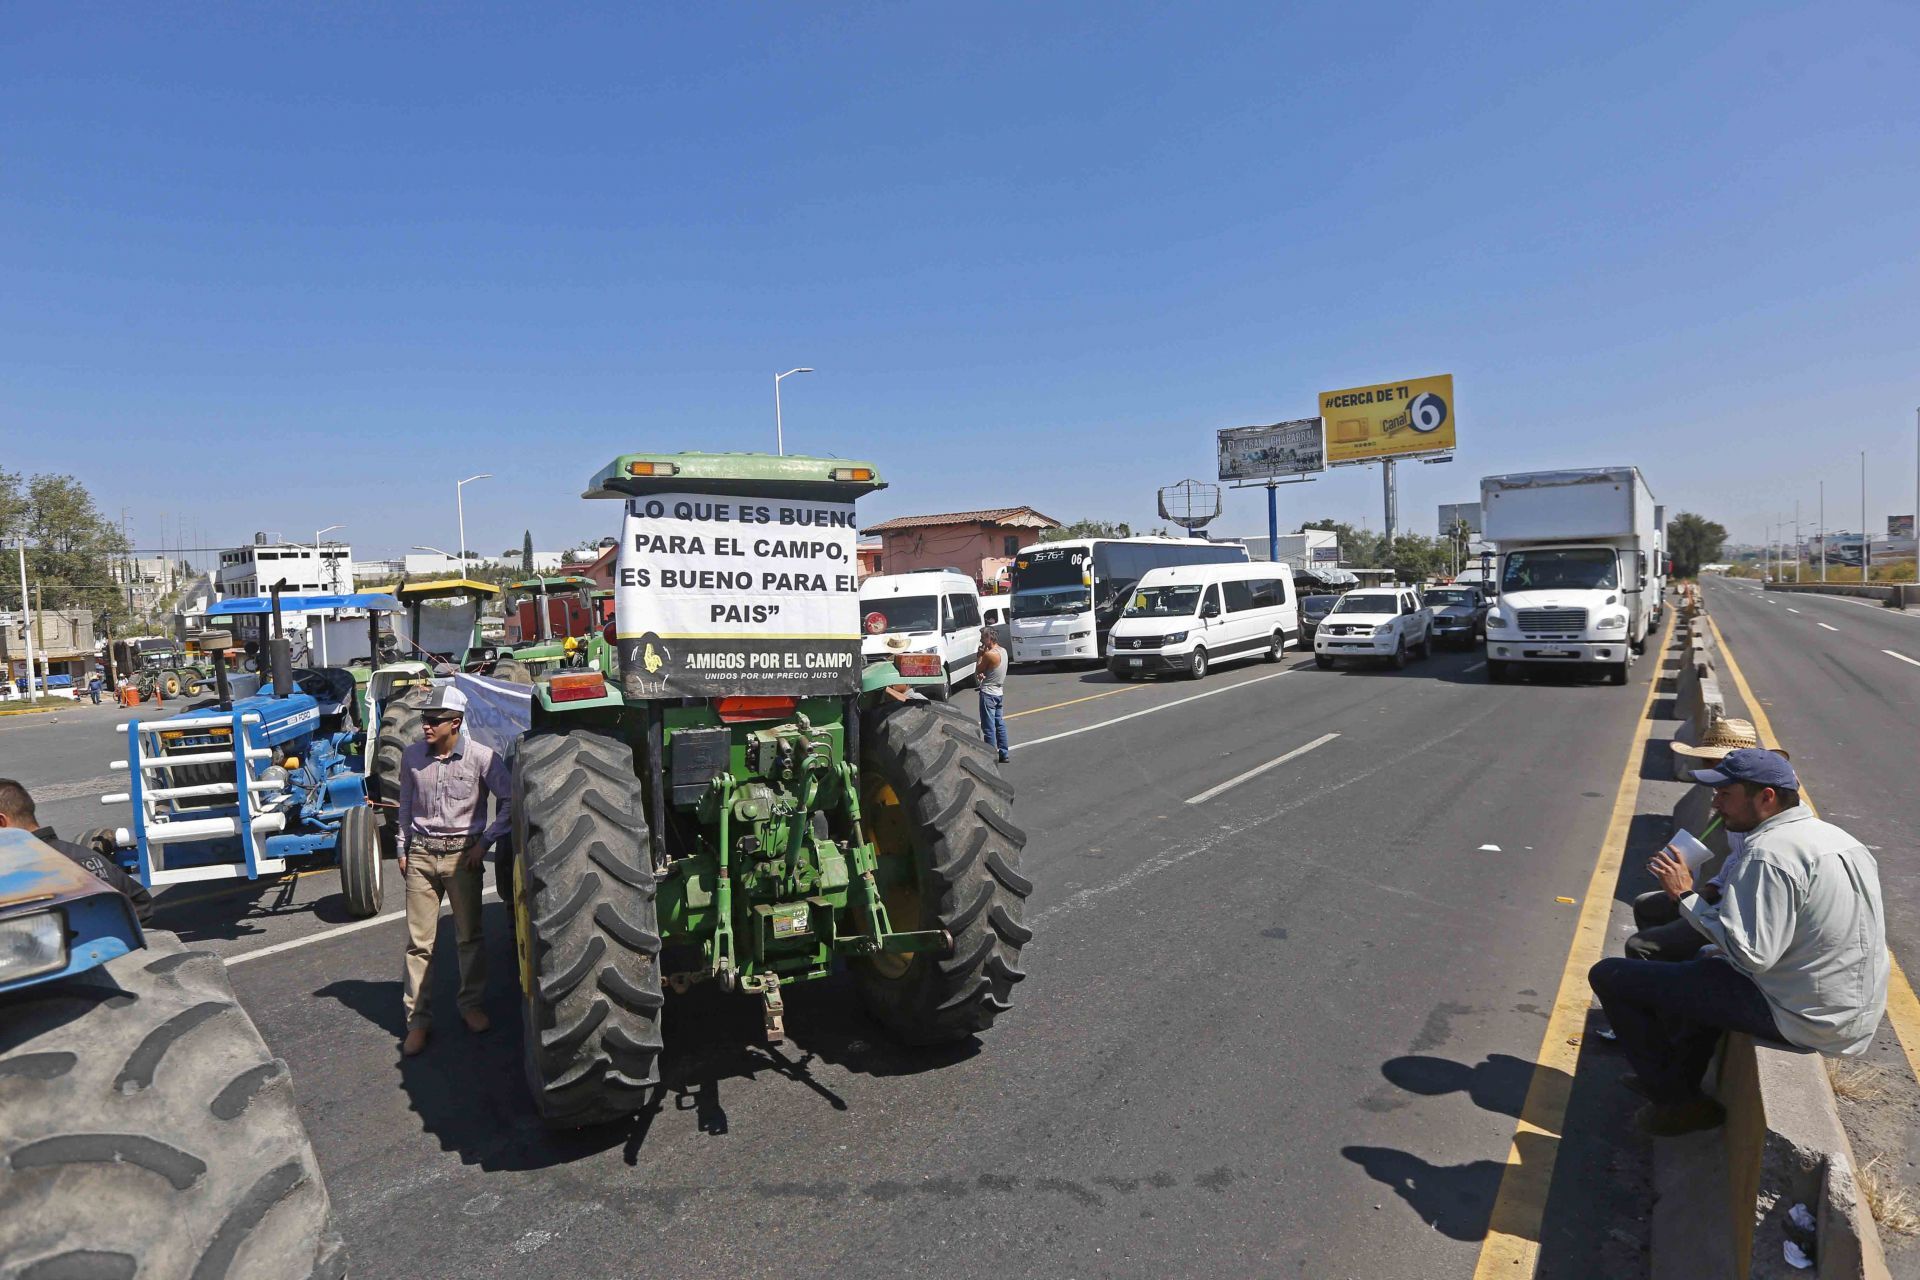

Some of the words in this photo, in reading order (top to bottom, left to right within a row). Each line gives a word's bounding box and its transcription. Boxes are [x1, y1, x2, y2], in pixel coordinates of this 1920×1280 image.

[1325, 392, 1374, 409] #CERCA
[1376, 389, 1394, 403] DE
[1396, 386, 1409, 399] TI
[1382, 411, 1408, 433] Canal
[1411, 392, 1441, 432] 6
[674, 502, 729, 522] QUE
[739, 506, 771, 524] ES
[635, 534, 706, 555] PARA
[714, 538, 745, 557] EL
[753, 539, 849, 564] CAMPO,
[1071, 553, 1083, 565] 06
[620, 568, 651, 587] ES
[660, 569, 753, 590] BUENO
[762, 572, 827, 592] PARA
[835, 575, 857, 593] EL
[685, 653, 746, 669] AMIGOS
[749, 653, 780, 668] POR
[784, 653, 802, 668] EL
[805, 653, 853, 669] CAMPO
[704, 672, 738, 680] UNIDOS
[776, 672, 808, 680] PRECIO
